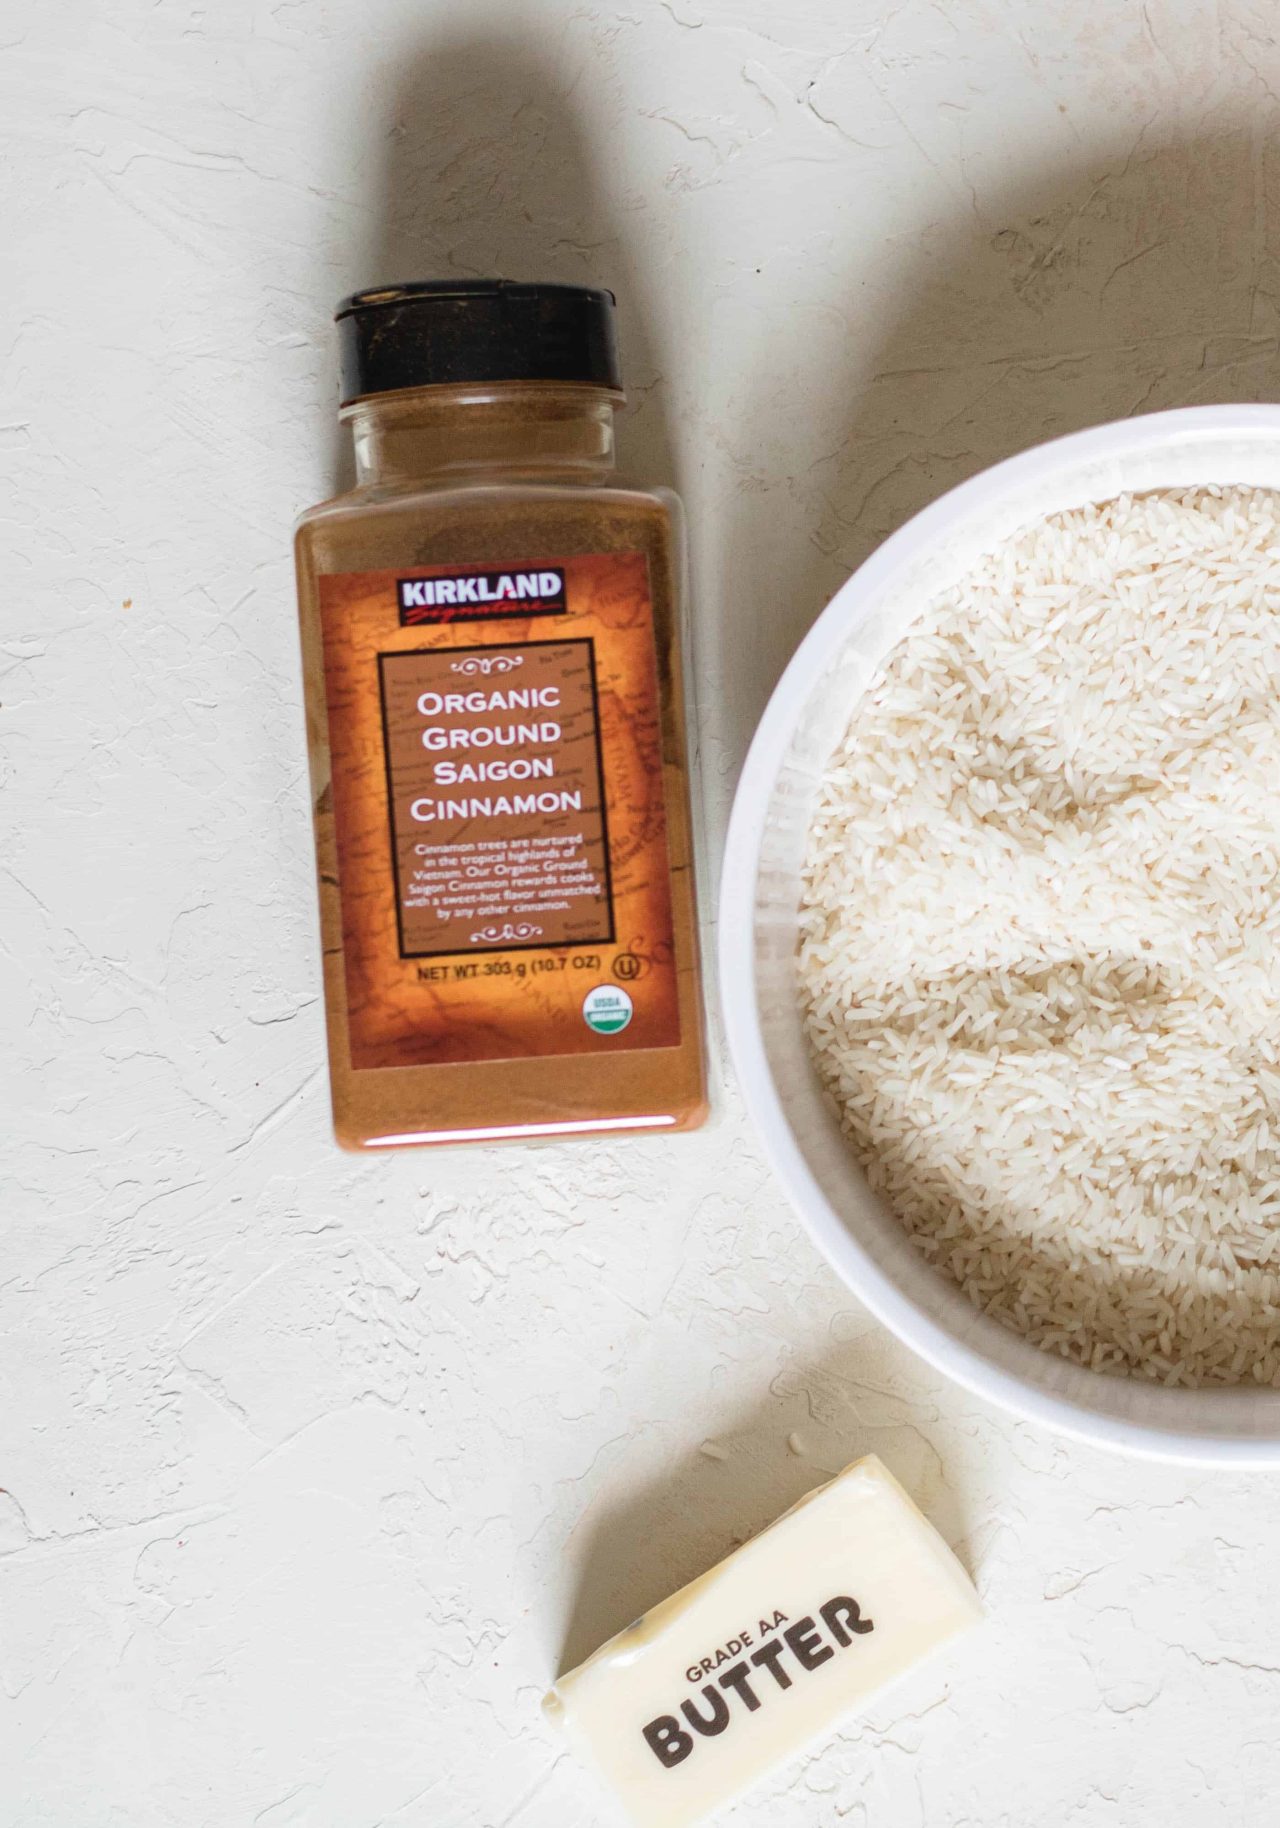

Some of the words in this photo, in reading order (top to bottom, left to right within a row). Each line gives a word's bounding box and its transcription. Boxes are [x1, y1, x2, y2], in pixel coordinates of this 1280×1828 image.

[402, 572, 562, 607] KIRKLAND
[405, 601, 561, 624] Signature
[417, 687, 561, 716] ORGANIC
[422, 722, 561, 750] GROUND
[433, 758, 554, 785] SAIGON
[410, 791, 582, 821] CINNAMON
[415, 843, 475, 855] Cinnamon
[477, 840, 507, 850] trees
[510, 838, 529, 848] are
[532, 833, 583, 846] nurtured
[438, 855, 458, 866] the
[461, 852, 505, 866] tropical
[508, 848, 560, 863] highlands
[466, 866, 491, 877] Our
[494, 864, 540, 877] Organic
[543, 859, 588, 871] Ground
[403, 896, 430, 907] with
[442, 891, 501, 905] sweet-hot
[503, 889, 535, 900] flavor
[538, 884, 601, 898] unmatched
[408, 883, 446, 896] Saigon
[448, 880, 508, 892] Cinnamon
[511, 874, 557, 887] rewards
[560, 872, 595, 884] cooks
[454, 907, 474, 919] any
[477, 902, 510, 916] other
[512, 900, 572, 913] cinnamon.
[417, 966, 449, 981] NET
[484, 960, 512, 976] 303
[516, 962, 527, 977] g
[531, 957, 567, 975] (10.7
[572, 955, 601, 970] OZ)
[686, 1631, 754, 1683] GRADE
[758, 1610, 789, 1638] AA
[642, 1596, 875, 1769] BUTTER
